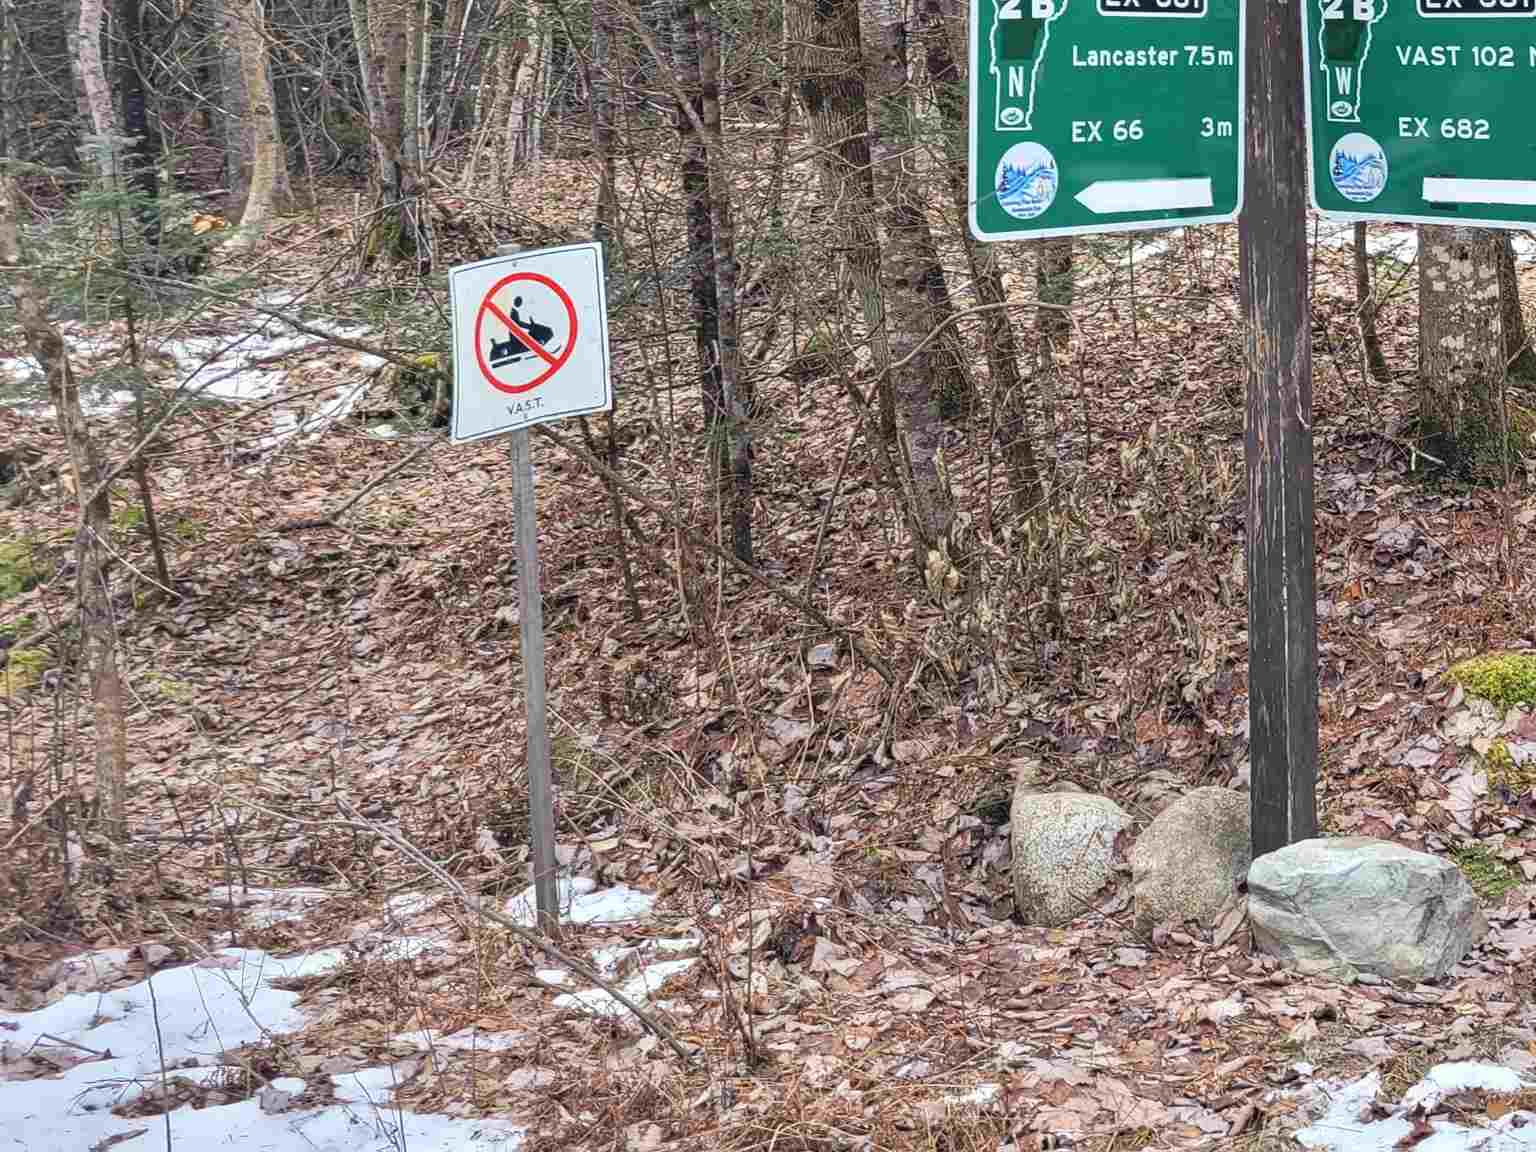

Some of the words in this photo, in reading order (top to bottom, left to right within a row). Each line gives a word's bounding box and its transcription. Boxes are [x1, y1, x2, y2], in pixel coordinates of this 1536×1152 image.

[1072, 45, 1178, 67] Lancaster
[1395, 46, 1460, 66] VAST
[1472, 47, 1515, 67] 102
[1009, 66, 1024, 97] N
[1335, 67, 1351, 95] W
[1072, 121, 1102, 142] EX
[1113, 120, 1144, 140] 66
[1398, 117, 1430, 137] EX
[1441, 119, 1490, 139] 682
